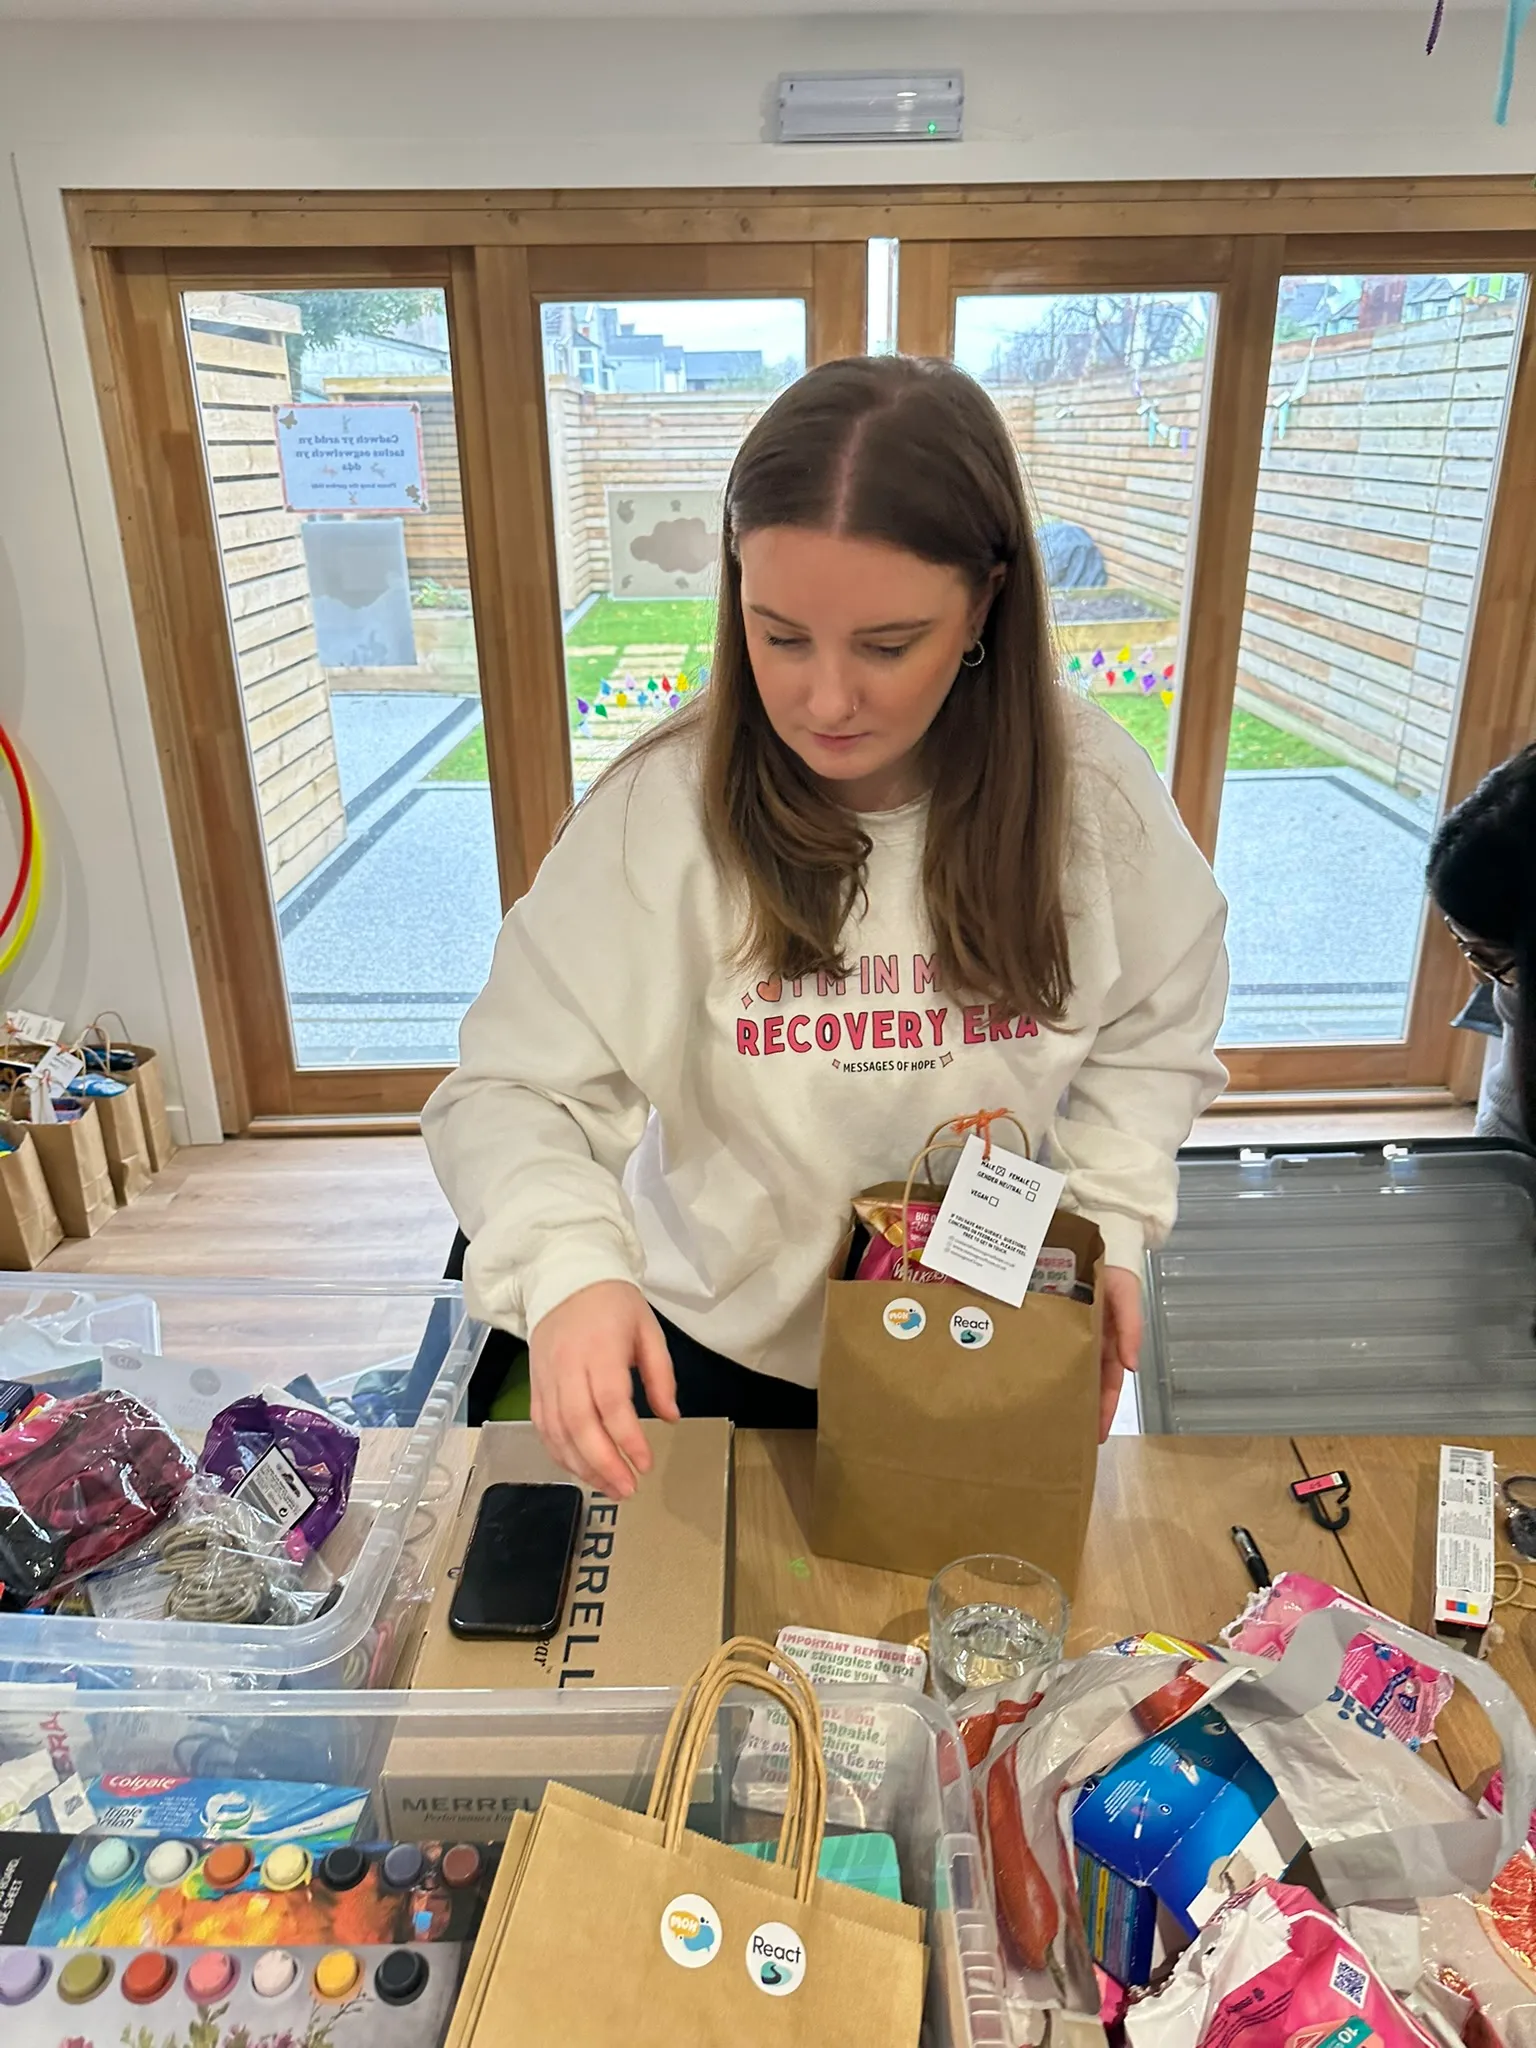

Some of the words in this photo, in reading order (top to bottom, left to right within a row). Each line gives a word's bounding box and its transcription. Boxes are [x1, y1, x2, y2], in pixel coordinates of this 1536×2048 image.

[860, 954, 899, 995] IN
[736, 1007, 949, 1057] RECOVERY
[843, 1060, 895, 1073] MESSAGES
[896, 1061, 909, 1072] OF
[911, 1060, 936, 1071] HOPE
[976, 1170, 999, 1183] GENDER
[998, 1180, 1023, 1195] NEUTRAL
[980, 1160, 995, 1170] MALE
[1008, 1172, 1030, 1186] FEMALE
[969, 1188, 989, 1201] VEGAN
[915, 1211, 929, 1222] BIG
[953, 1315, 990, 1330] React
[558, 1490, 619, 1689] ERRELL
[782, 1633, 850, 1653] IMPORTANT
[853, 1645, 922, 1666] REMINDERS
[810, 1662, 852, 1678] define
[811, 1650, 872, 1669] struggles
[874, 1660, 891, 1673] do
[891, 1665, 915, 1678] not
[109, 1775, 177, 1791] Colgate
[402, 1797, 538, 1812] MERREL
[752, 1935, 802, 1964] React
[1338, 2025, 1359, 2044] 10
